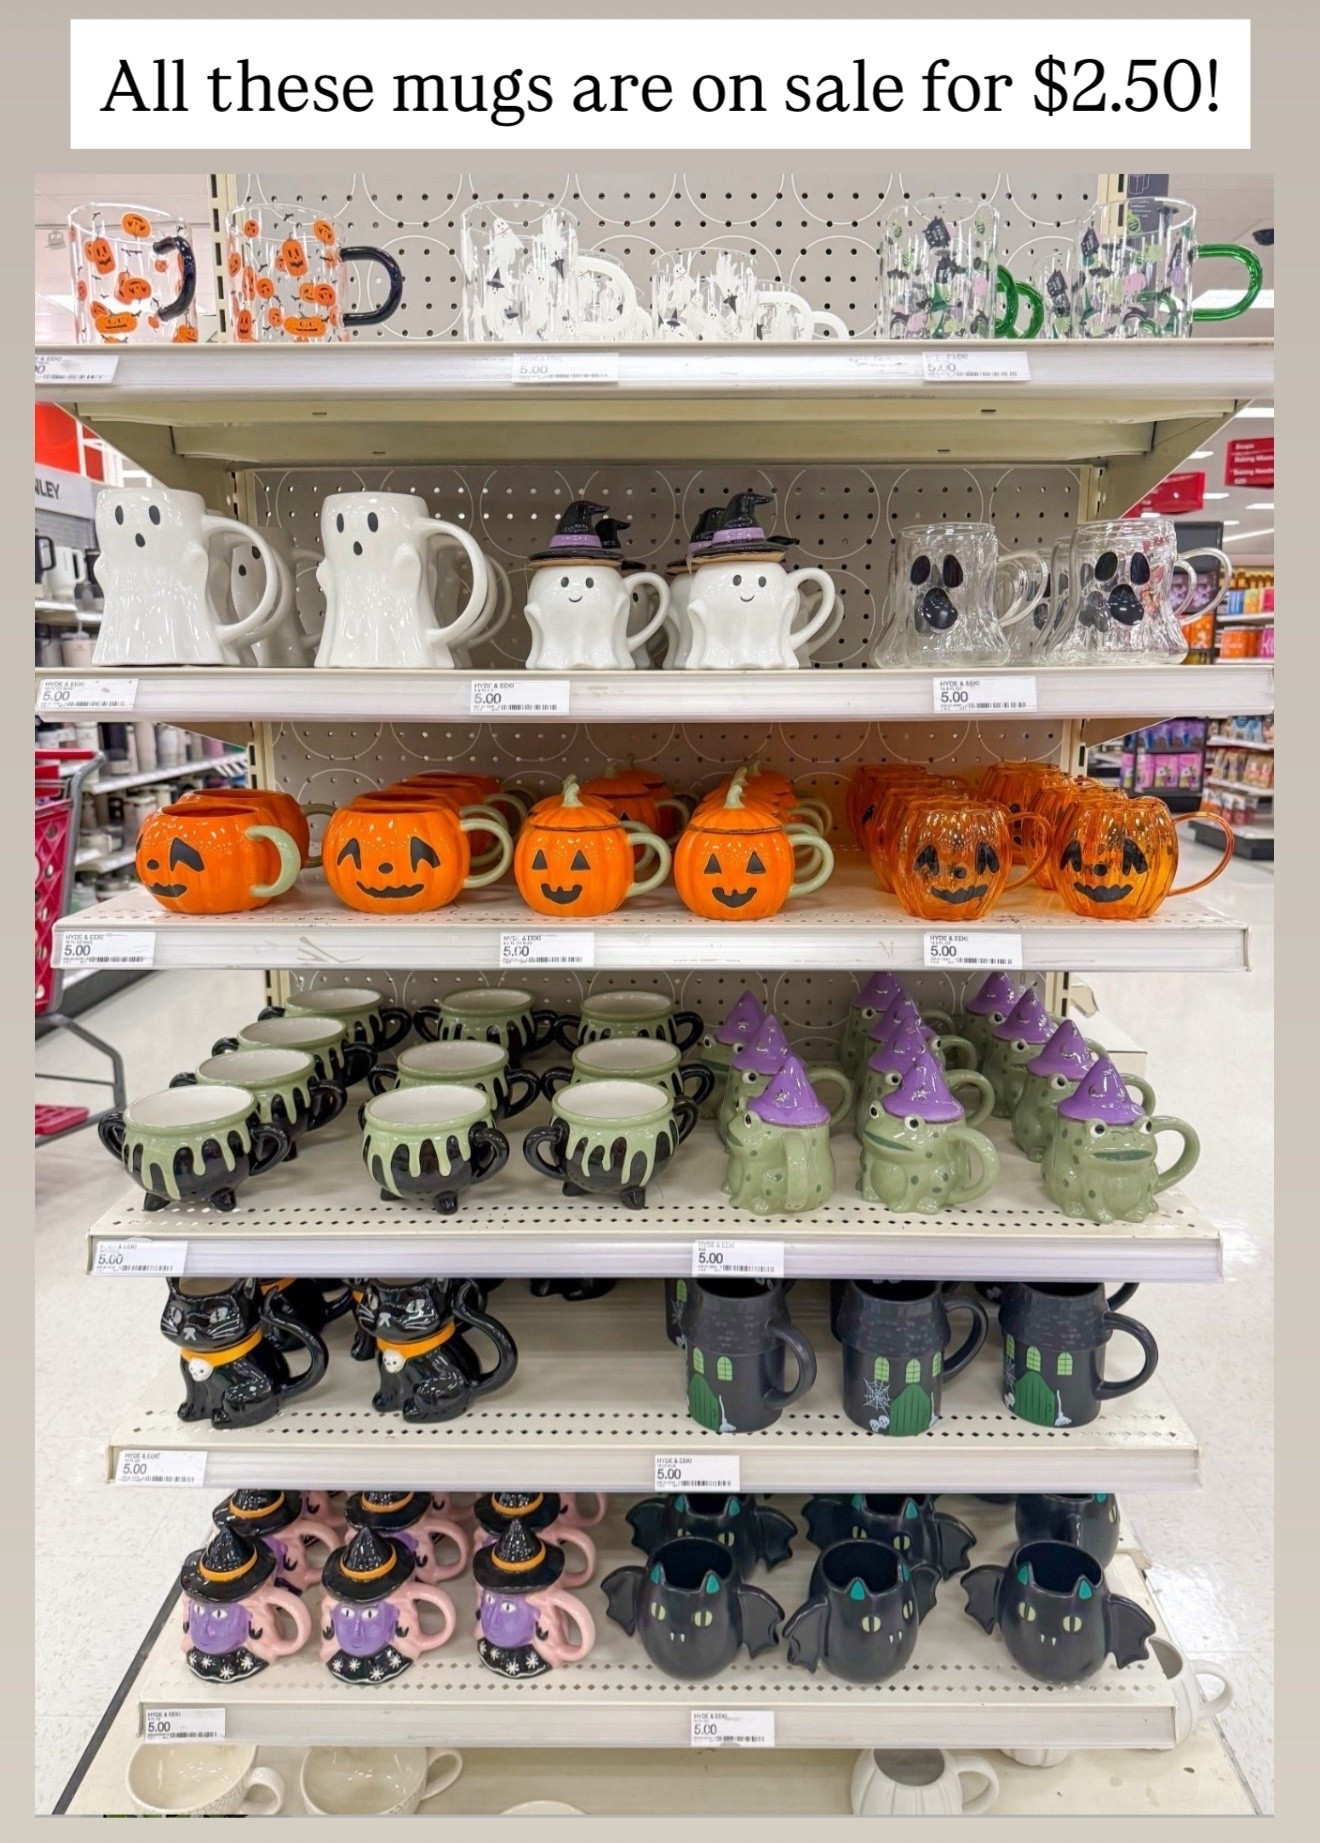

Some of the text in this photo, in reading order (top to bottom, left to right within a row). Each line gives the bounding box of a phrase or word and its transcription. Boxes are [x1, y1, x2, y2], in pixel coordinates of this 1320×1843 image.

[519, 365, 548, 374] 5.00
[43, 691, 70, 701] 5.00
[474, 693, 502, 704] 5.00
[941, 691, 969, 703] 5.00
[64, 945, 91, 956] 5.00
[503, 946, 530, 957] 5.00
[930, 945, 957, 957] 5.00
[98, 1254, 123, 1265] 5.00
[698, 1252, 723, 1264] 5.00
[123, 1463, 148, 1475] 5.00
[657, 1468, 681, 1480] 5.00
[148, 1721, 171, 1733] 5.00
[694, 1723, 717, 1735] 5.00
